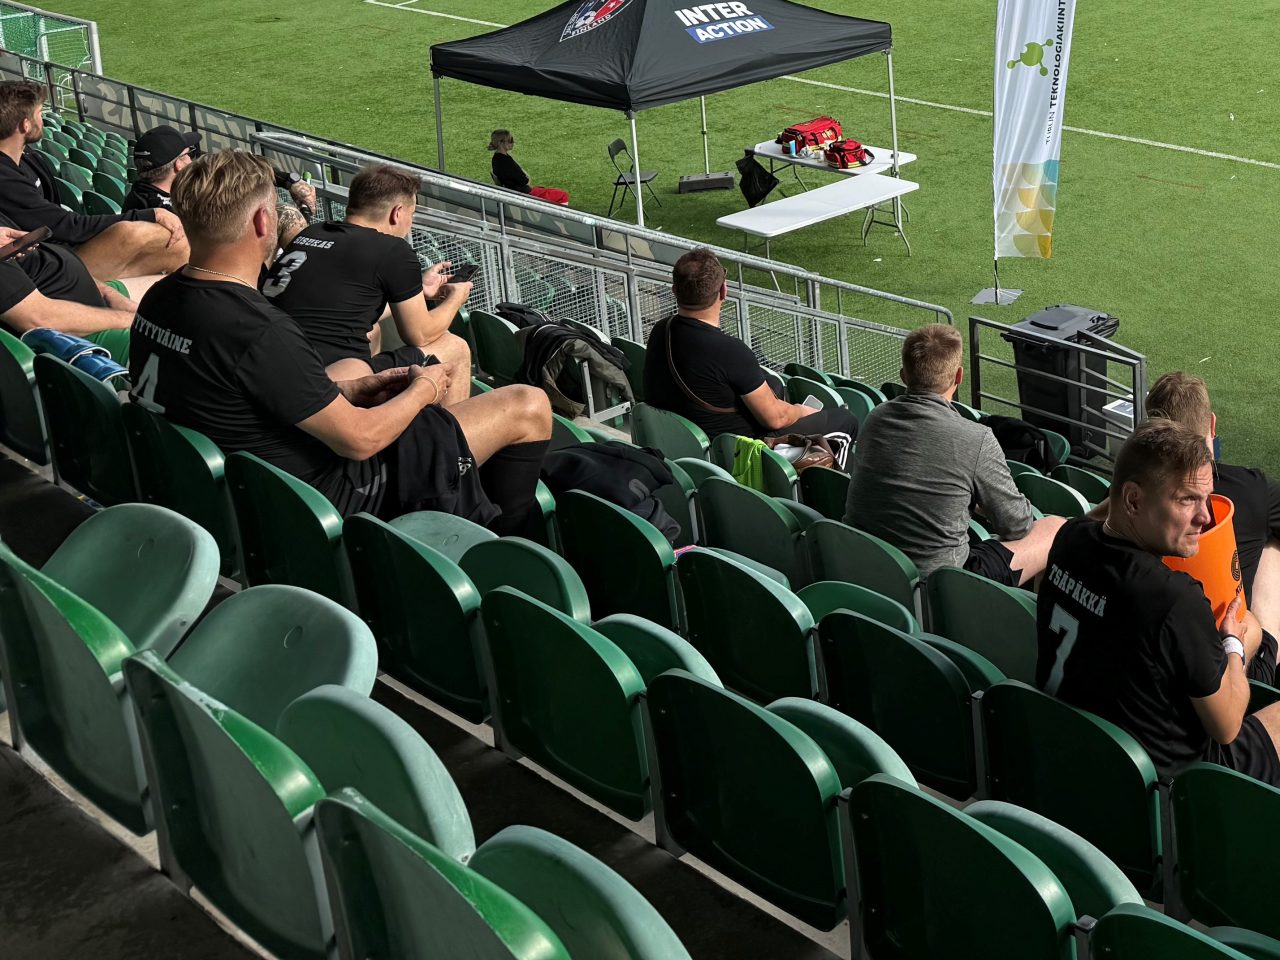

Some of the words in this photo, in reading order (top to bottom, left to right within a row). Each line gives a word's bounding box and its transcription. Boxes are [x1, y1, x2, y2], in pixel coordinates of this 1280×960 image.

[674, 1, 755, 27] INTER
[695, 17, 768, 42] ACTION
[262, 250, 308, 298] 3
[130, 352, 166, 414] 4
[1048, 563, 1107, 618] TSÄPÄKKÄ
[1043, 602, 1080, 698] 7
